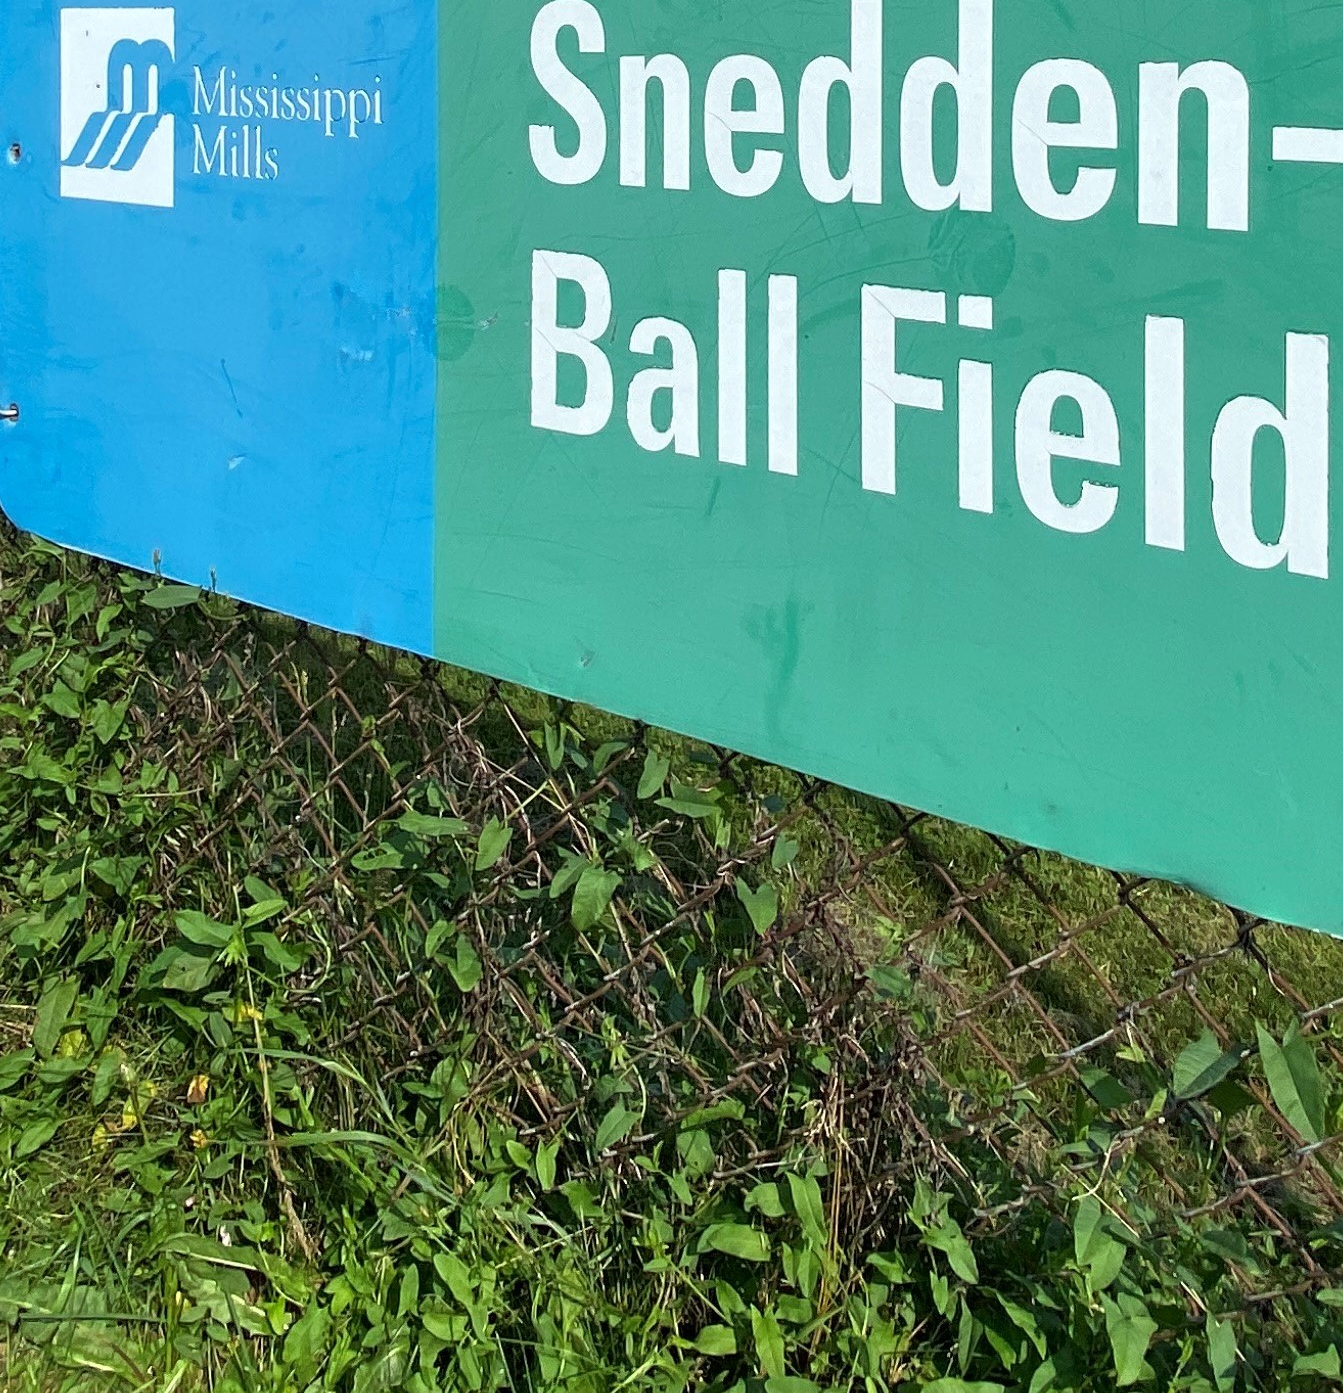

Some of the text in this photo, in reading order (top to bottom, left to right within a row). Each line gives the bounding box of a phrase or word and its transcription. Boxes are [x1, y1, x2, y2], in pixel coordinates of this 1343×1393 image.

[192, 64, 385, 139] Mississippi
[192, 123, 280, 181] Mills
[531, 250, 1329, 579] Ball Field
